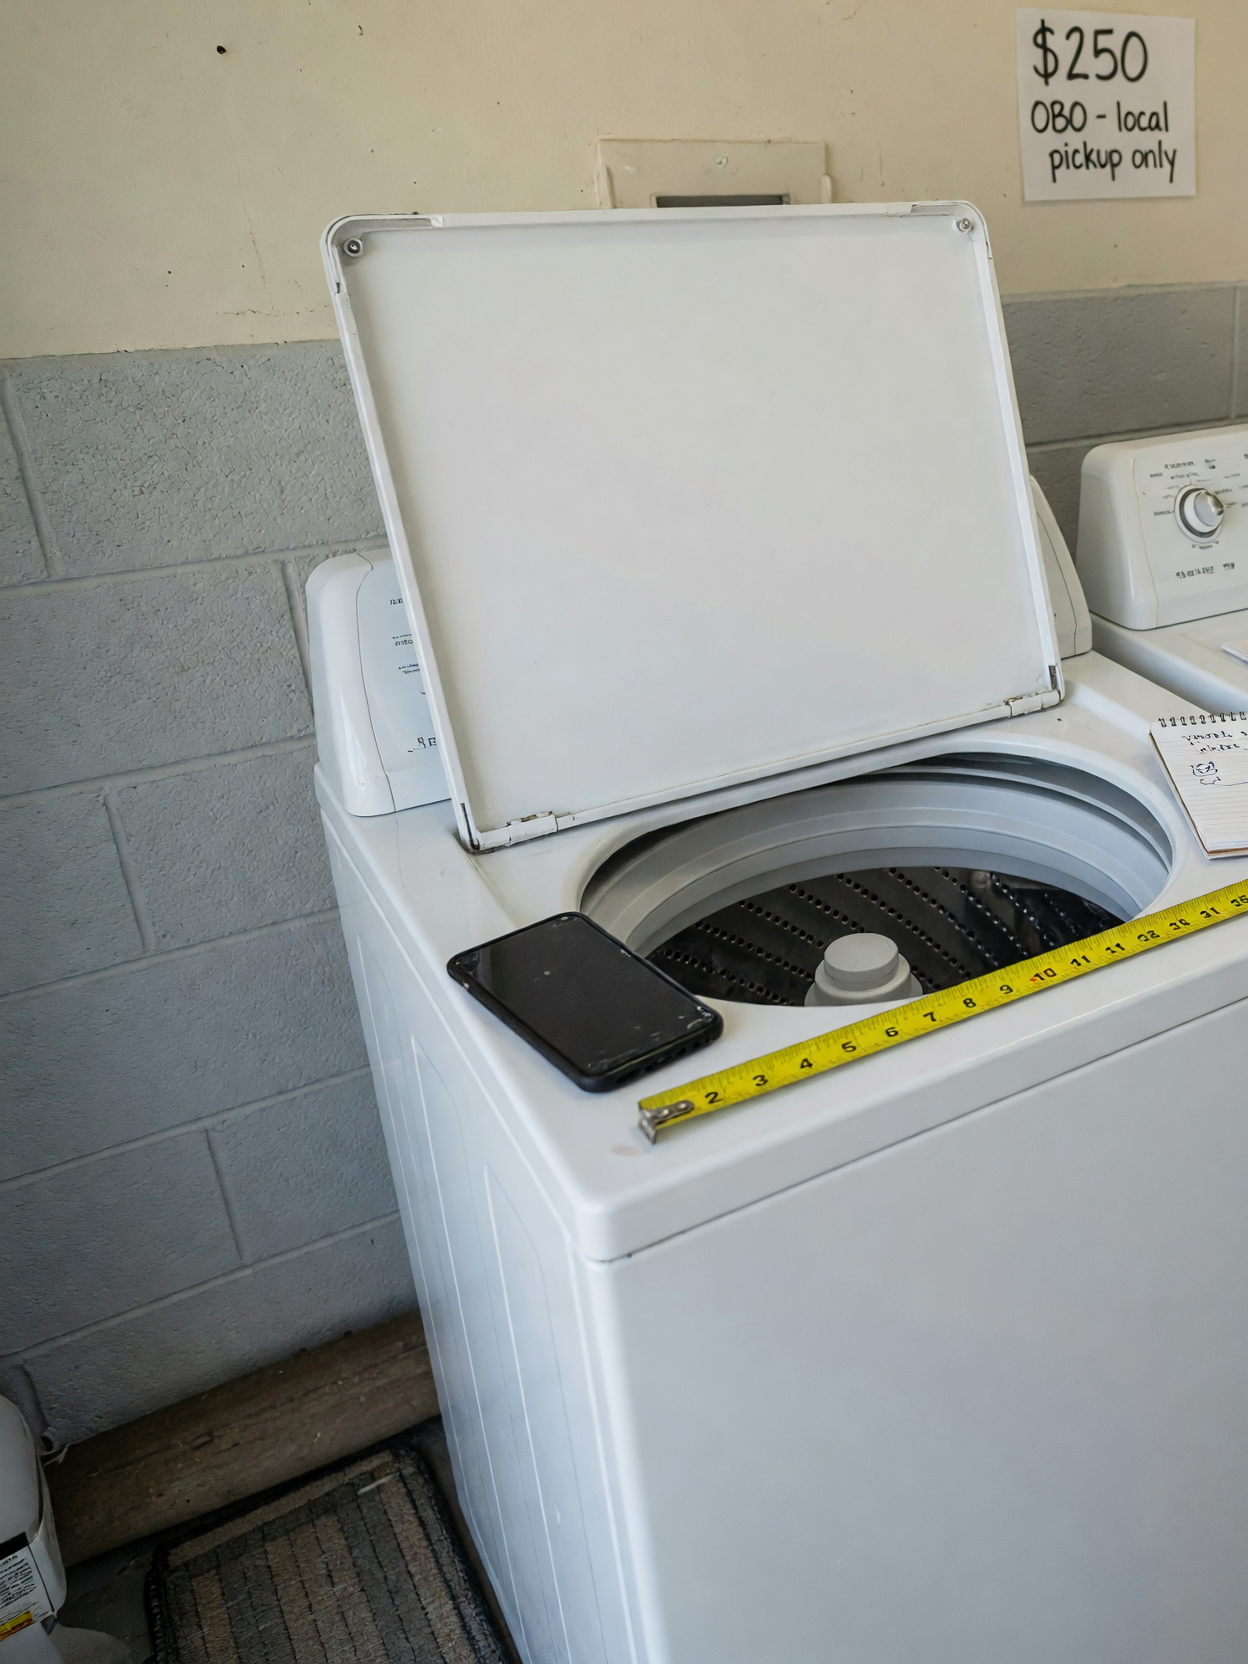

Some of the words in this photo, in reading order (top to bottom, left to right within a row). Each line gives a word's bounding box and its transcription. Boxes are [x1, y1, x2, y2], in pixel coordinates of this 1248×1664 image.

[1032, 19, 1148, 86] $250
[1031, 100, 1087, 133] OBO
[1116, 100, 1169, 132] local
[1048, 140, 1122, 183] pickup
[1132, 140, 1177, 183] only
[704, 1091, 723, 1104] 2
[752, 1074, 769, 1087] 3
[799, 1058, 814, 1070] 4
[841, 1041, 857, 1053] 5
[885, 1026, 900, 1038] 6
[922, 1011, 938, 1023] 7
[962, 997, 977, 1009] 8
[999, 984, 1014, 995] 9
[1032, 967, 1058, 981] 10
